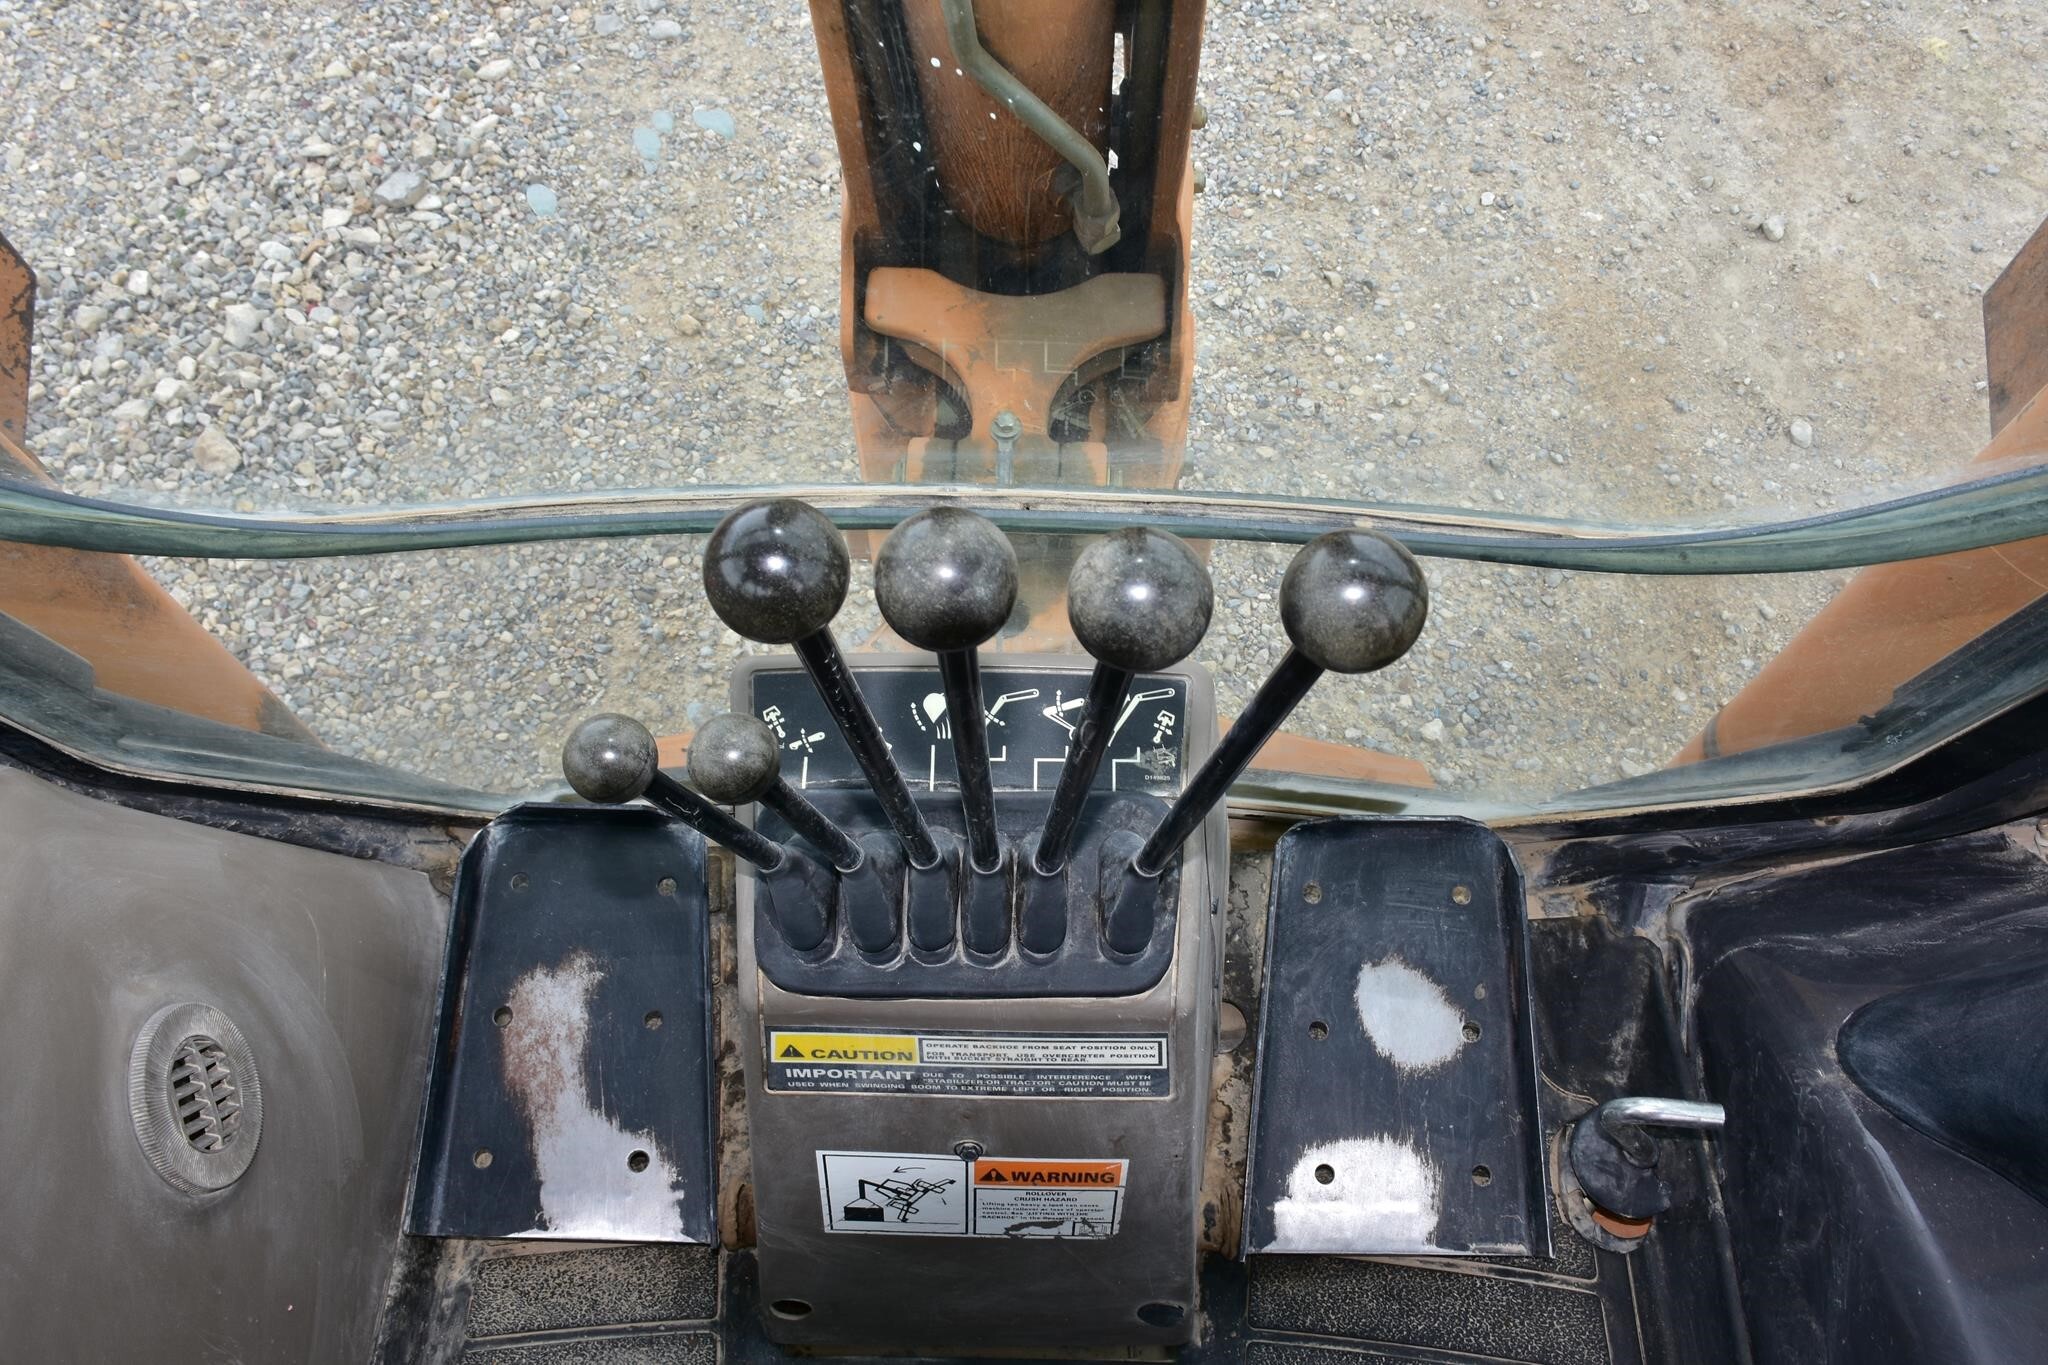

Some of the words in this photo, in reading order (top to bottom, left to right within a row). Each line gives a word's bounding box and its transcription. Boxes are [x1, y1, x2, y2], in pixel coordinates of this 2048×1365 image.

[811, 1049, 914, 1061] CAUTION
[785, 1068, 915, 1081] IMPORTANT
[1010, 1171, 1115, 1184] WARNING
